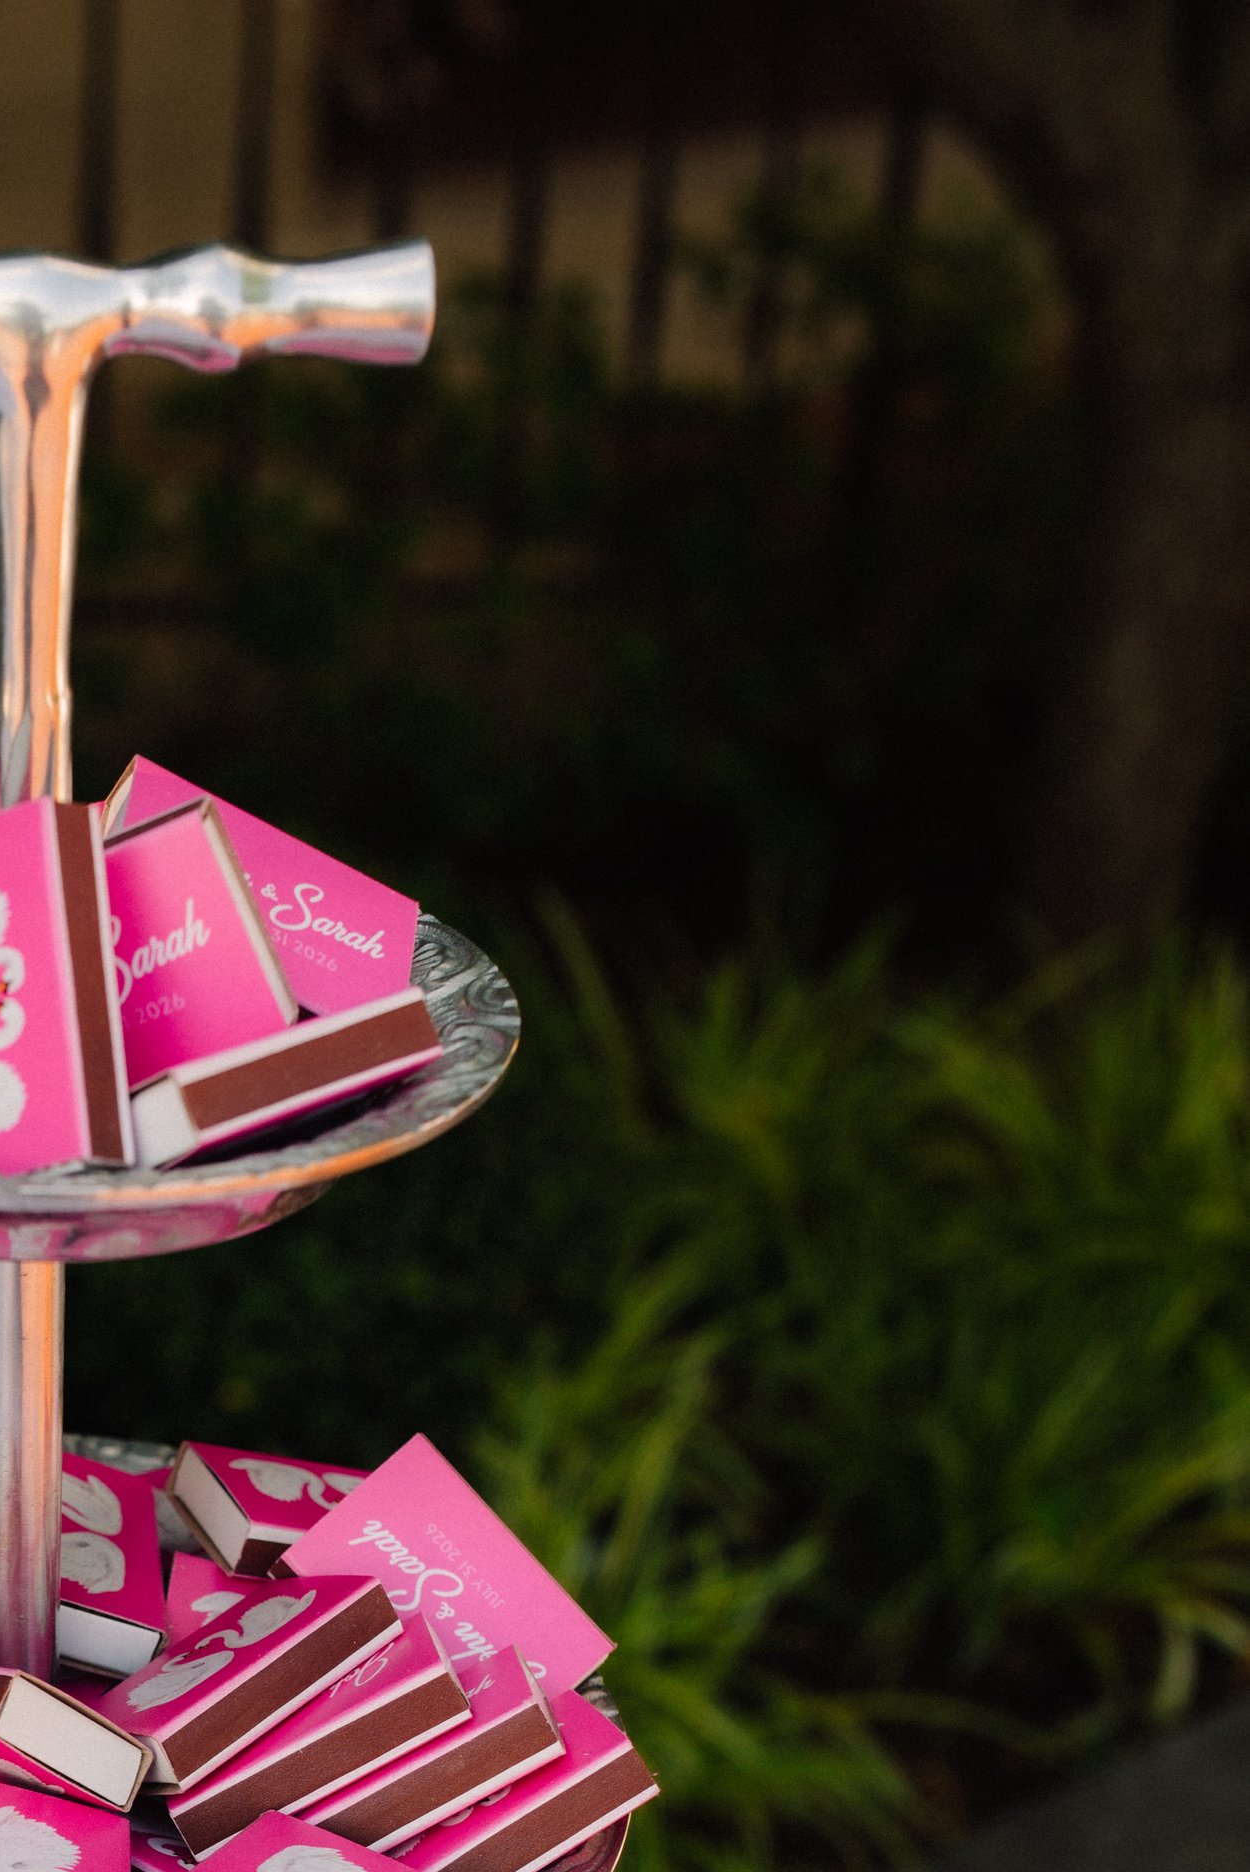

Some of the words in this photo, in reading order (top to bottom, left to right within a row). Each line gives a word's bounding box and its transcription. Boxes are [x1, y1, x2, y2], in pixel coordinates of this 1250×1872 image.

[260, 883, 279, 901] &
[269, 883, 385, 960] Sarah
[293, 939, 338, 972] 2026
[136, 992, 186, 1025] 2026
[426, 1522, 463, 1563] 2026
[348, 1519, 465, 1612] Sarah
[473, 1577, 507, 1610] JULY
[435, 1601, 456, 1620] &
